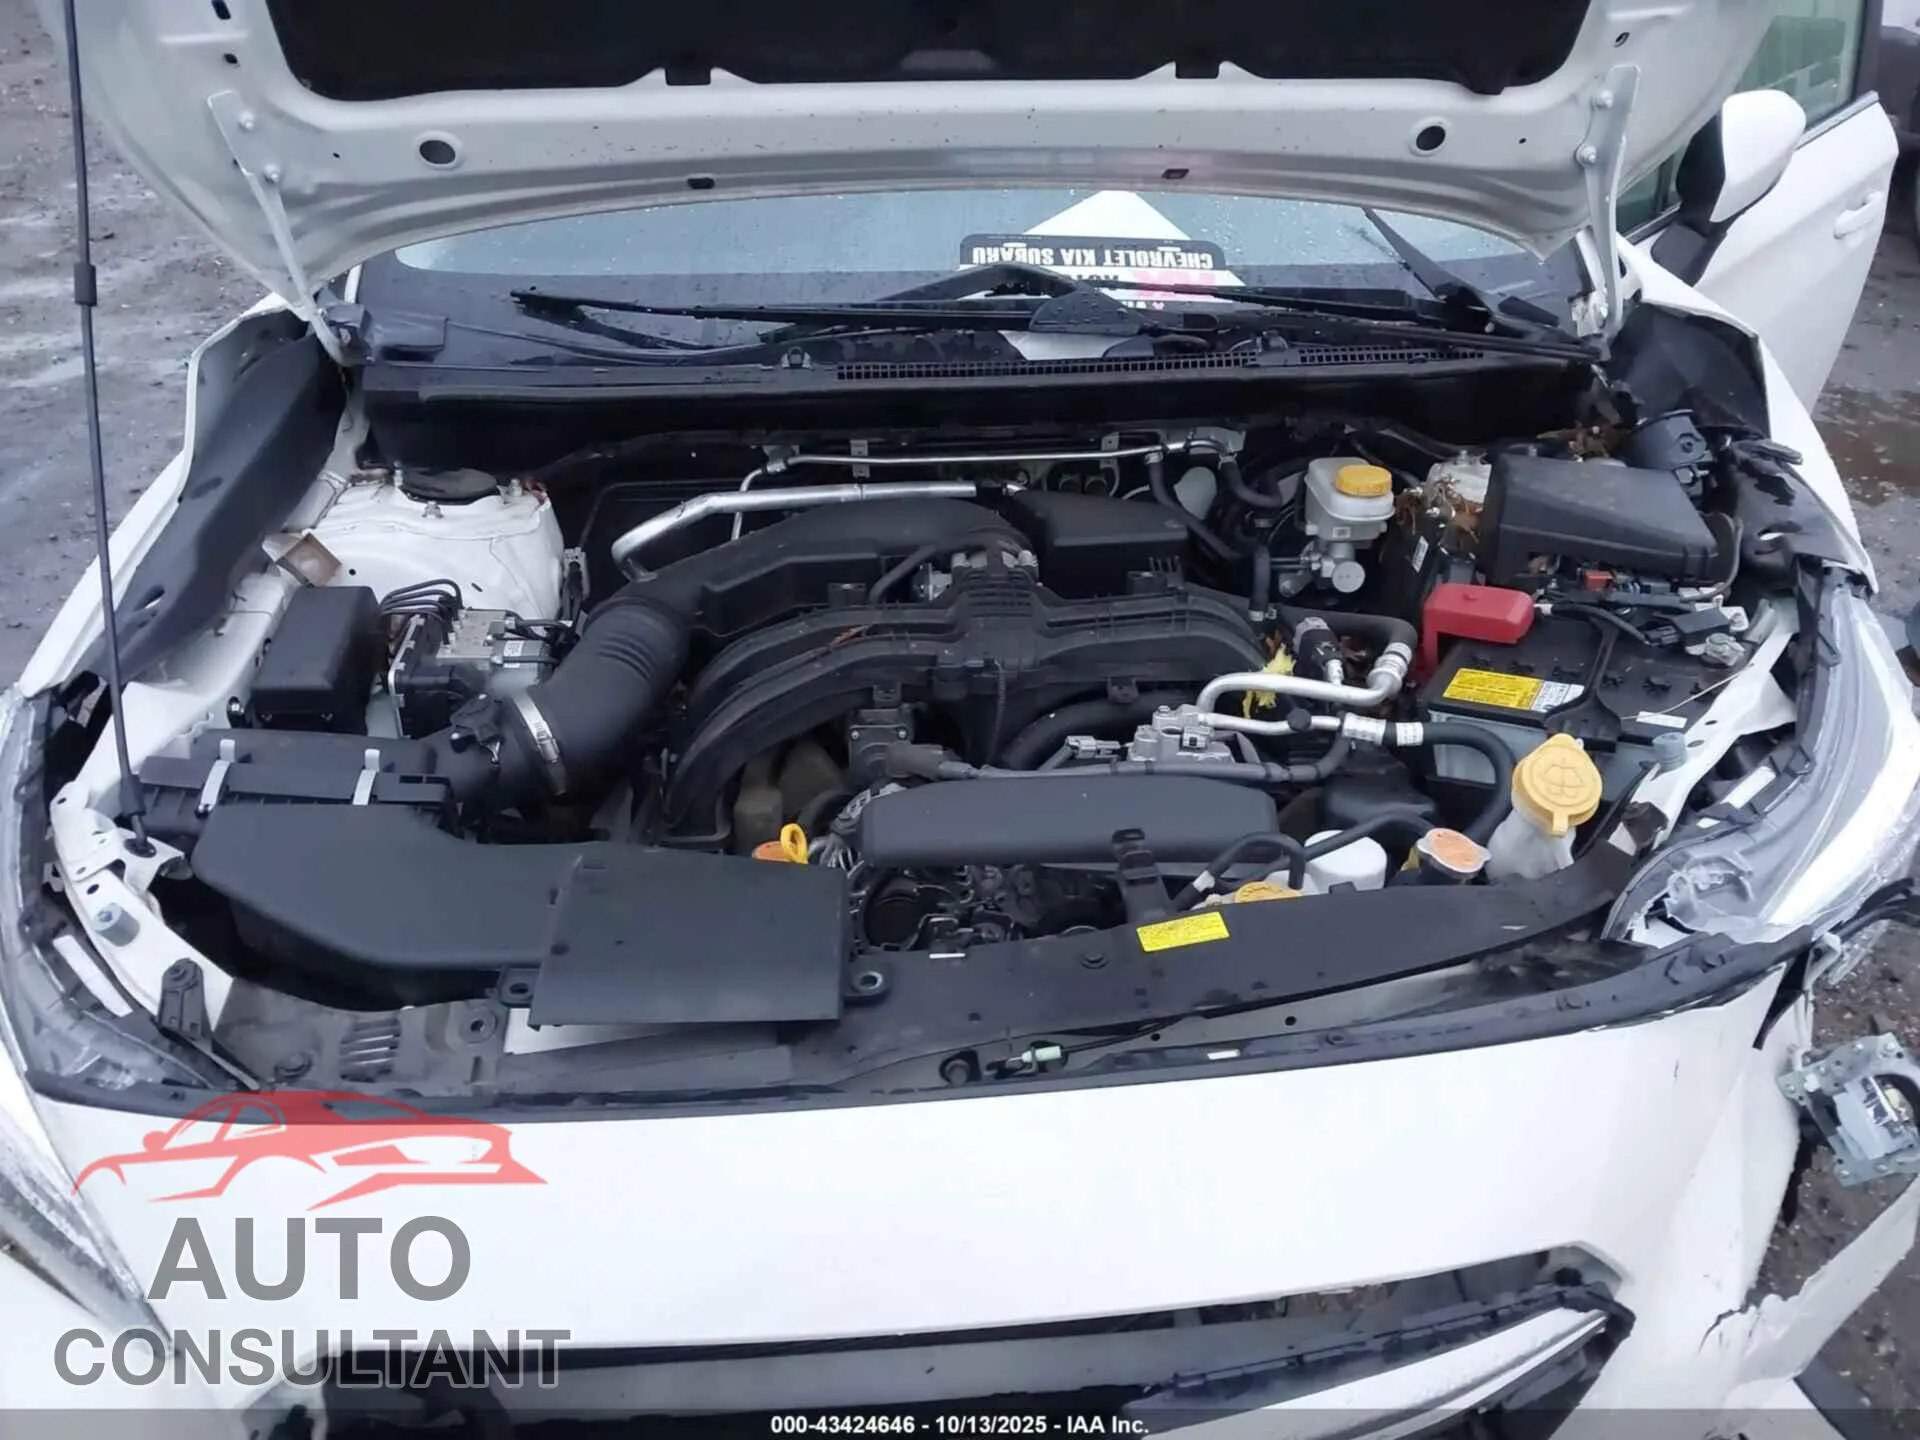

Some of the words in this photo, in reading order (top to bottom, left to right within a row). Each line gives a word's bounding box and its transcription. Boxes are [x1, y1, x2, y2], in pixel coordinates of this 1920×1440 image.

[972, 246, 1055, 265] SUBARU
[1060, 247, 1096, 266] KIA
[1103, 248, 1214, 269] CHEVROLET
